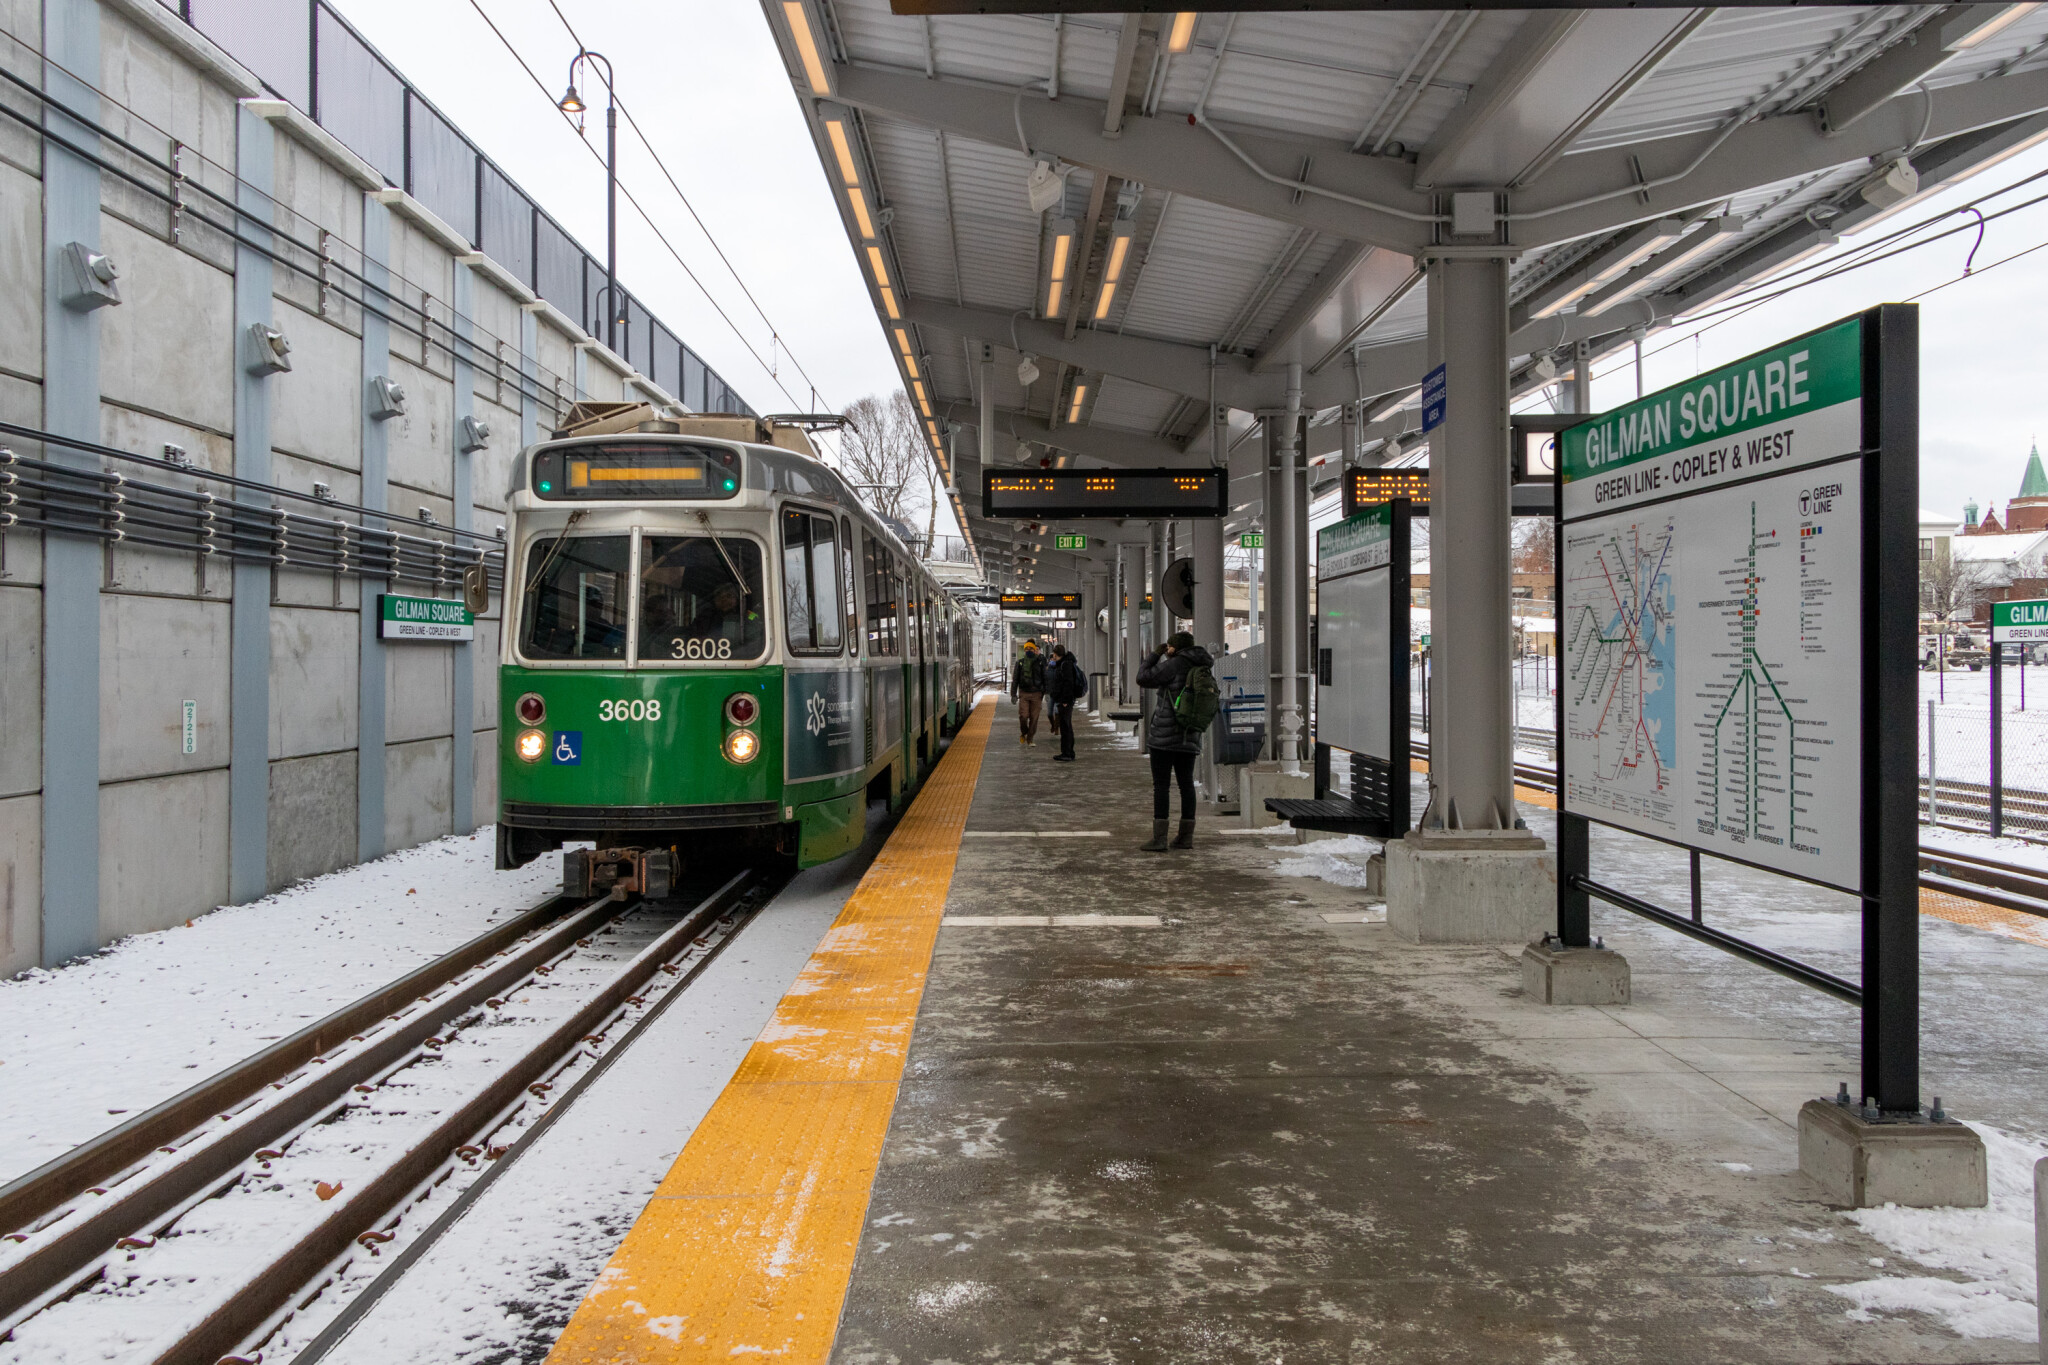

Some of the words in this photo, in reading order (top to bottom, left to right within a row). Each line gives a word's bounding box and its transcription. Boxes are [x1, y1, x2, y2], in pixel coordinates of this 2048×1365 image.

[1423, 371, 1444, 394] CUSTOMER
[1423, 387, 1445, 410] ASSISTANCE
[1428, 408, 1439, 423] AREA
[1585, 400, 1671, 468] GILMAN
[1679, 349, 1810, 440] SQUARE
[1595, 477, 1631, 504] GREEN
[1635, 466, 1660, 494] LINE
[1672, 448, 1728, 484] COPLEY
[1732, 444, 1742, 469] &
[1747, 429, 1794, 465] WEST
[1813, 483, 1842, 500] GREEN
[1813, 500, 1832, 515] LINE
[1350, 511, 1381, 546] SQUARE
[1059, 536, 1073, 548] EXIT
[395, 600, 430, 620] GILMAN
[431, 603, 465, 622] SQUARE
[399, 625, 415, 634] GREEN
[416, 626, 425, 635] LINE
[429, 626, 445, 636] COPLEY
[446, 628, 449, 636] &
[450, 628, 461, 636] WEST
[2009, 629, 2032, 638] GREEN
[671, 638, 732, 659] 3608
[598, 699, 661, 722] 3608
[1700, 819, 1715, 829] BOSTON
[1723, 825, 1745, 836] CLEVELAND
[1731, 834, 1745, 844] CIRCLE
[1757, 833, 1780, 845] RIVERSIDE
[1794, 843, 1809, 854] HEATH
[1810, 846, 1816, 854] ST
